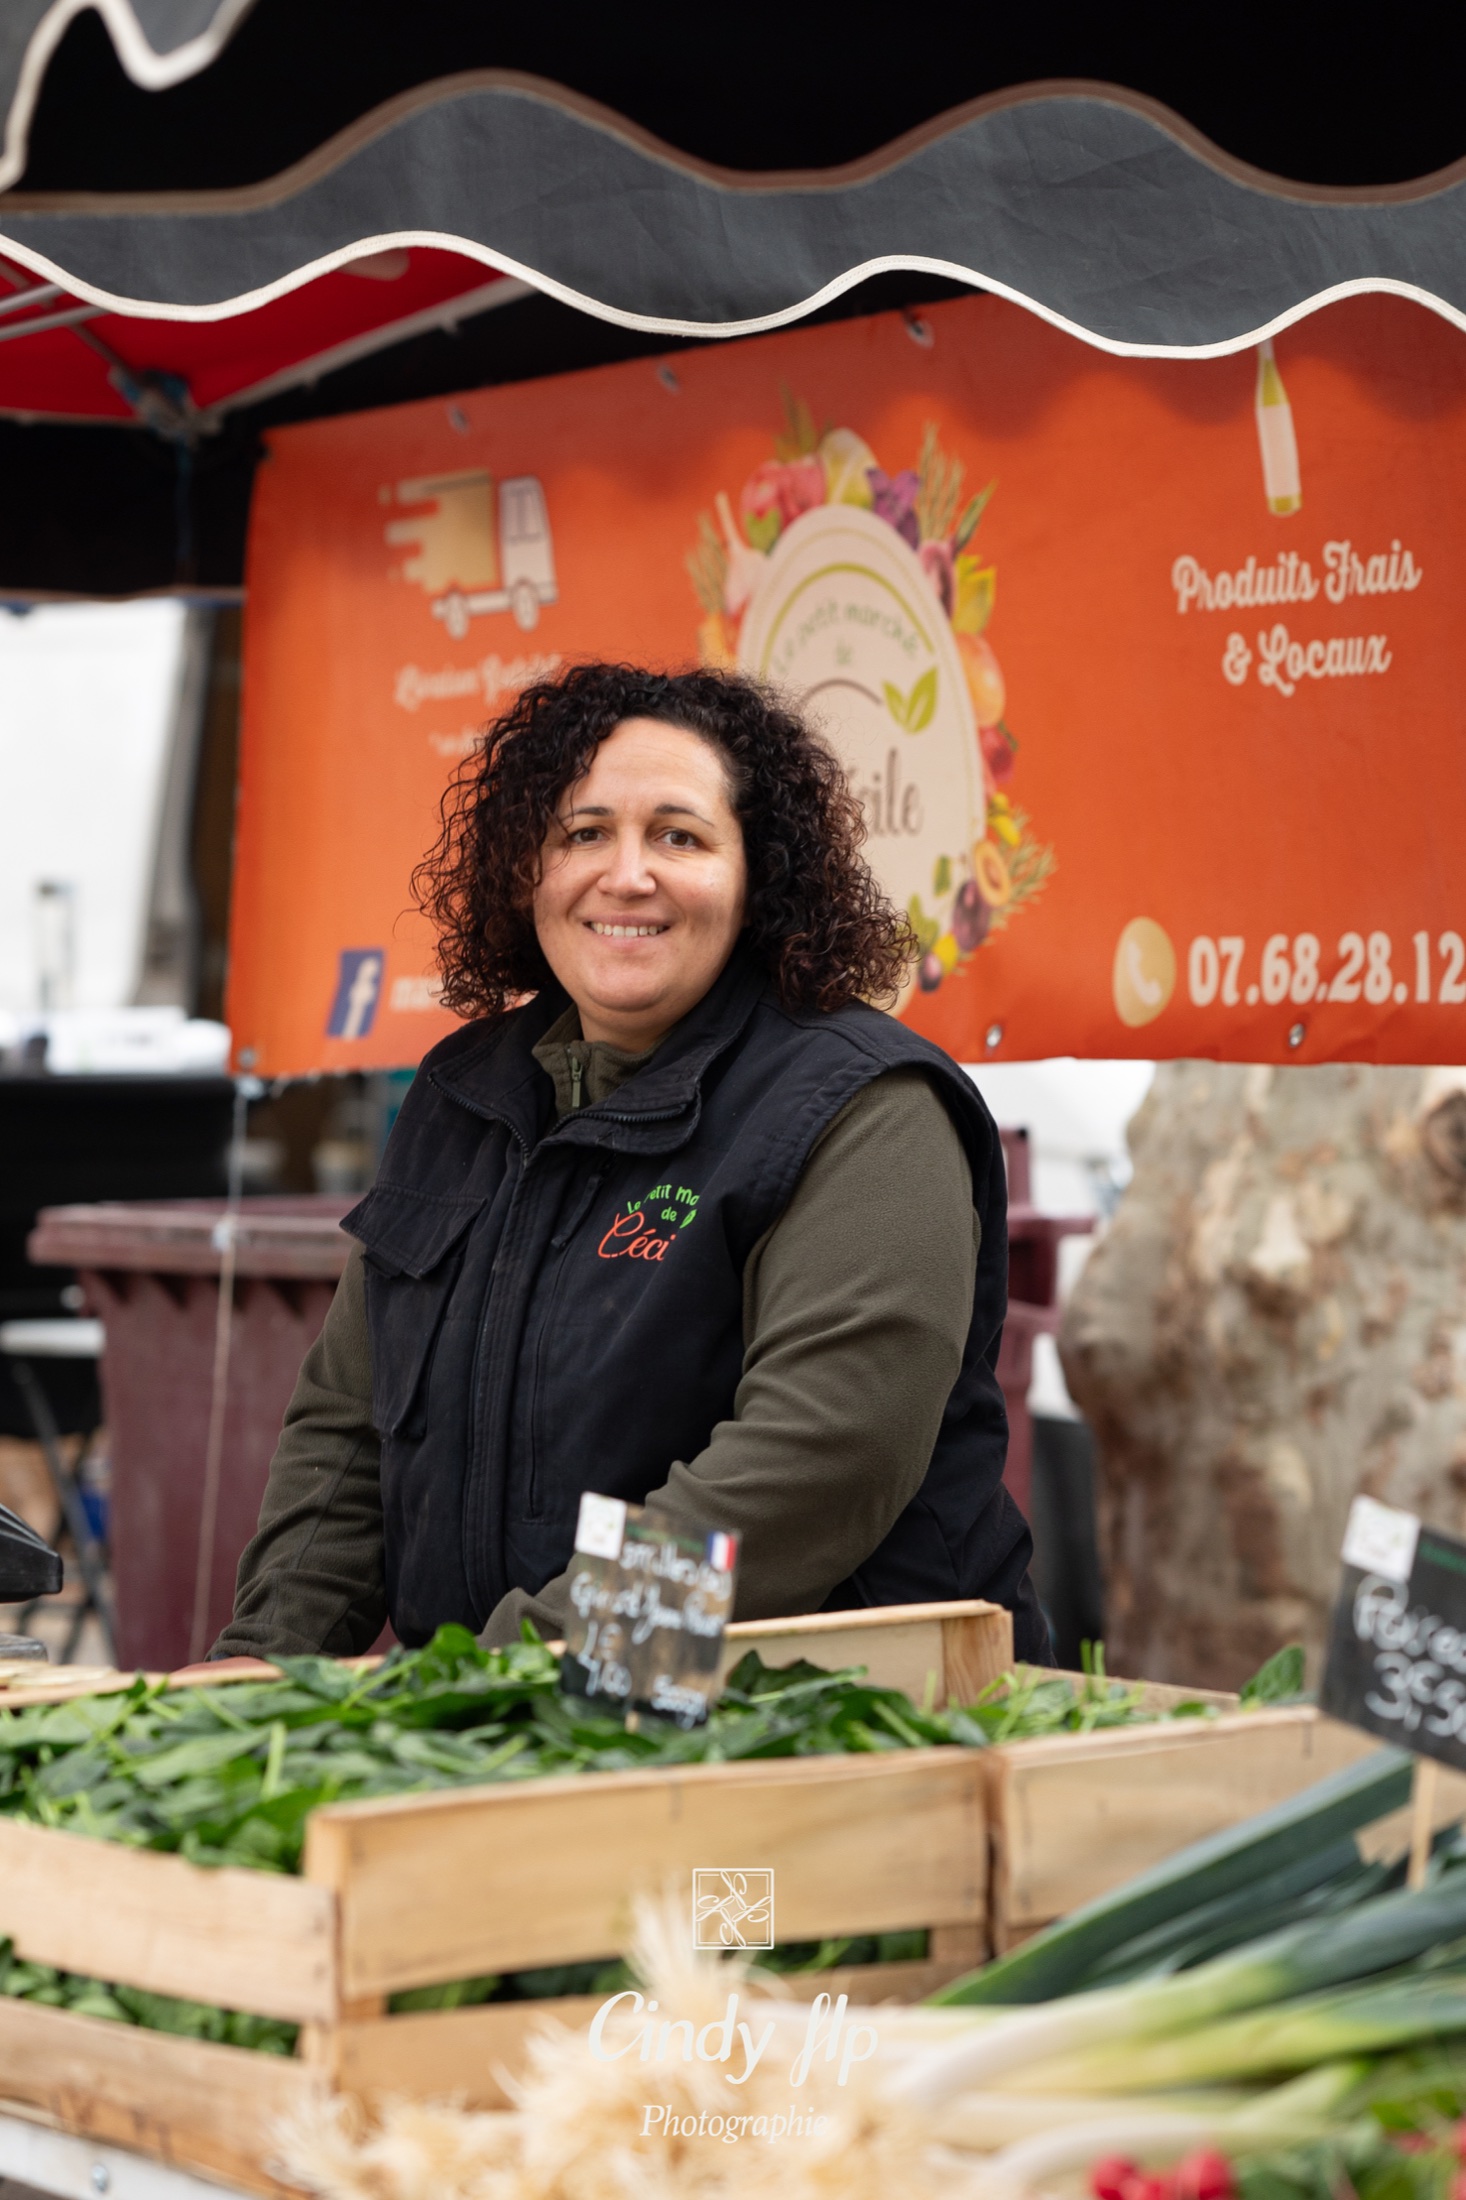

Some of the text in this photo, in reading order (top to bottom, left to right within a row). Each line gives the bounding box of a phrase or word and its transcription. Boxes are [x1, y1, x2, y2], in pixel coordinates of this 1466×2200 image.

[1172, 539, 1422, 614] Produits Frais
[1222, 623, 1392, 697] & Locaux
[644, 1184, 672, 1203] etit
[661, 1206, 678, 1222] de
